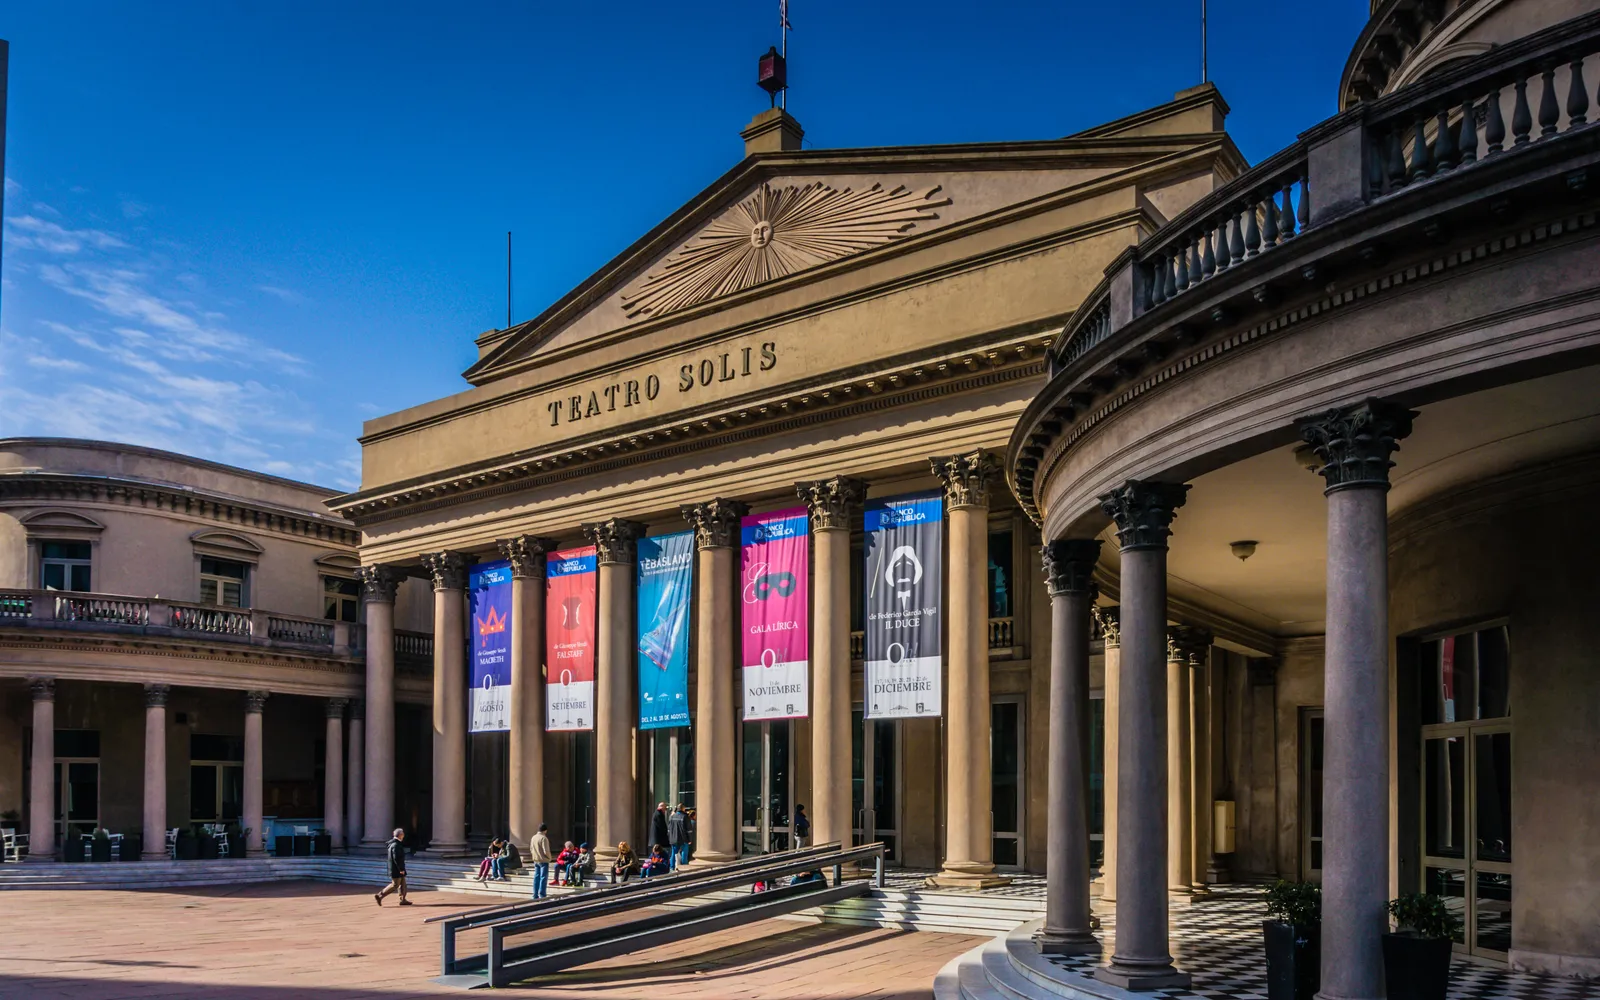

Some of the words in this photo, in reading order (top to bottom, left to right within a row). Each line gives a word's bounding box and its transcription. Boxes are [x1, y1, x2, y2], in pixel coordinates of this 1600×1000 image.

[547, 374, 660, 427] TEATRO
[678, 341, 777, 393] SOLIS
[891, 508, 914, 516] BANCO
[878, 612, 902, 620] Federico
[922, 606, 936, 616] Vigil
[750, 624, 772, 634] GALA
[772, 620, 798, 632] LÍRICA
[885, 620, 893, 630] IL
[895, 618, 920, 628] DUCE
[557, 650, 584, 659] FALSTAFF
[749, 684, 802, 696] NOVIEMBRE
[874, 682, 932, 694] DICIEMBRE
[480, 704, 504, 713] AGOSTO
[552, 701, 586, 710] SETIEMBRE
